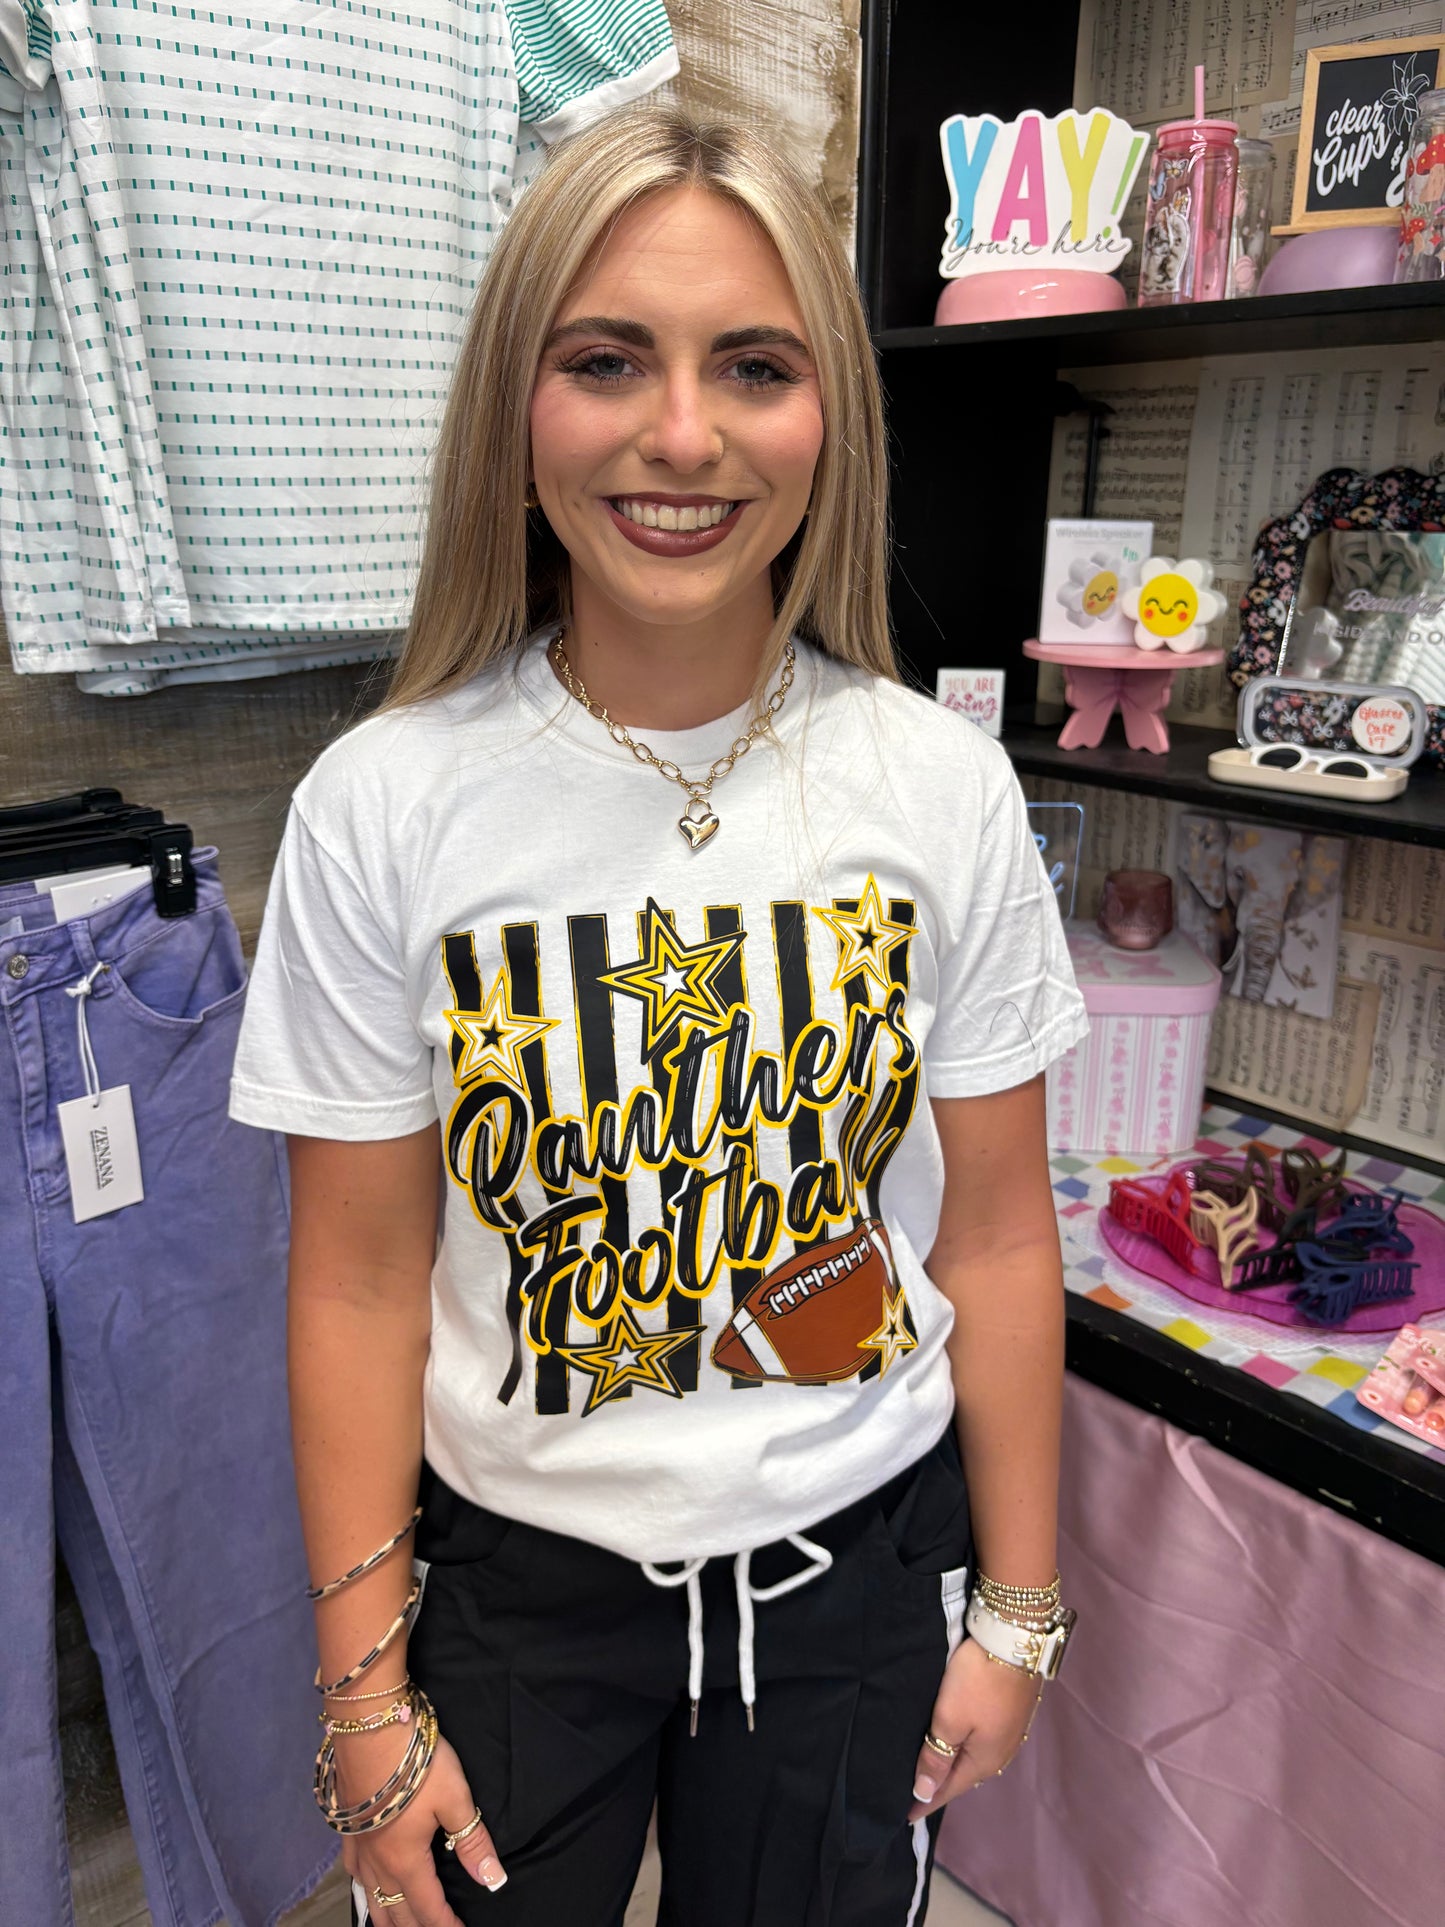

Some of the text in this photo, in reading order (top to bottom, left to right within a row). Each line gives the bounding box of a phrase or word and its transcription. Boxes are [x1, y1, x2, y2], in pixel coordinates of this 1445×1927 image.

[1325, 98, 1384, 139] clear
[946, 112, 1144, 248] YAY!
[1313, 122, 1391, 196] Cups
[945, 218, 1128, 272] You're here
[1101, 527, 1144, 541] Speaker
[974, 676, 996, 692] ARE
[447, 982, 919, 1230] Panthers
[94, 1126, 115, 1189] ZENANA
[520, 1078, 902, 1354] Football
